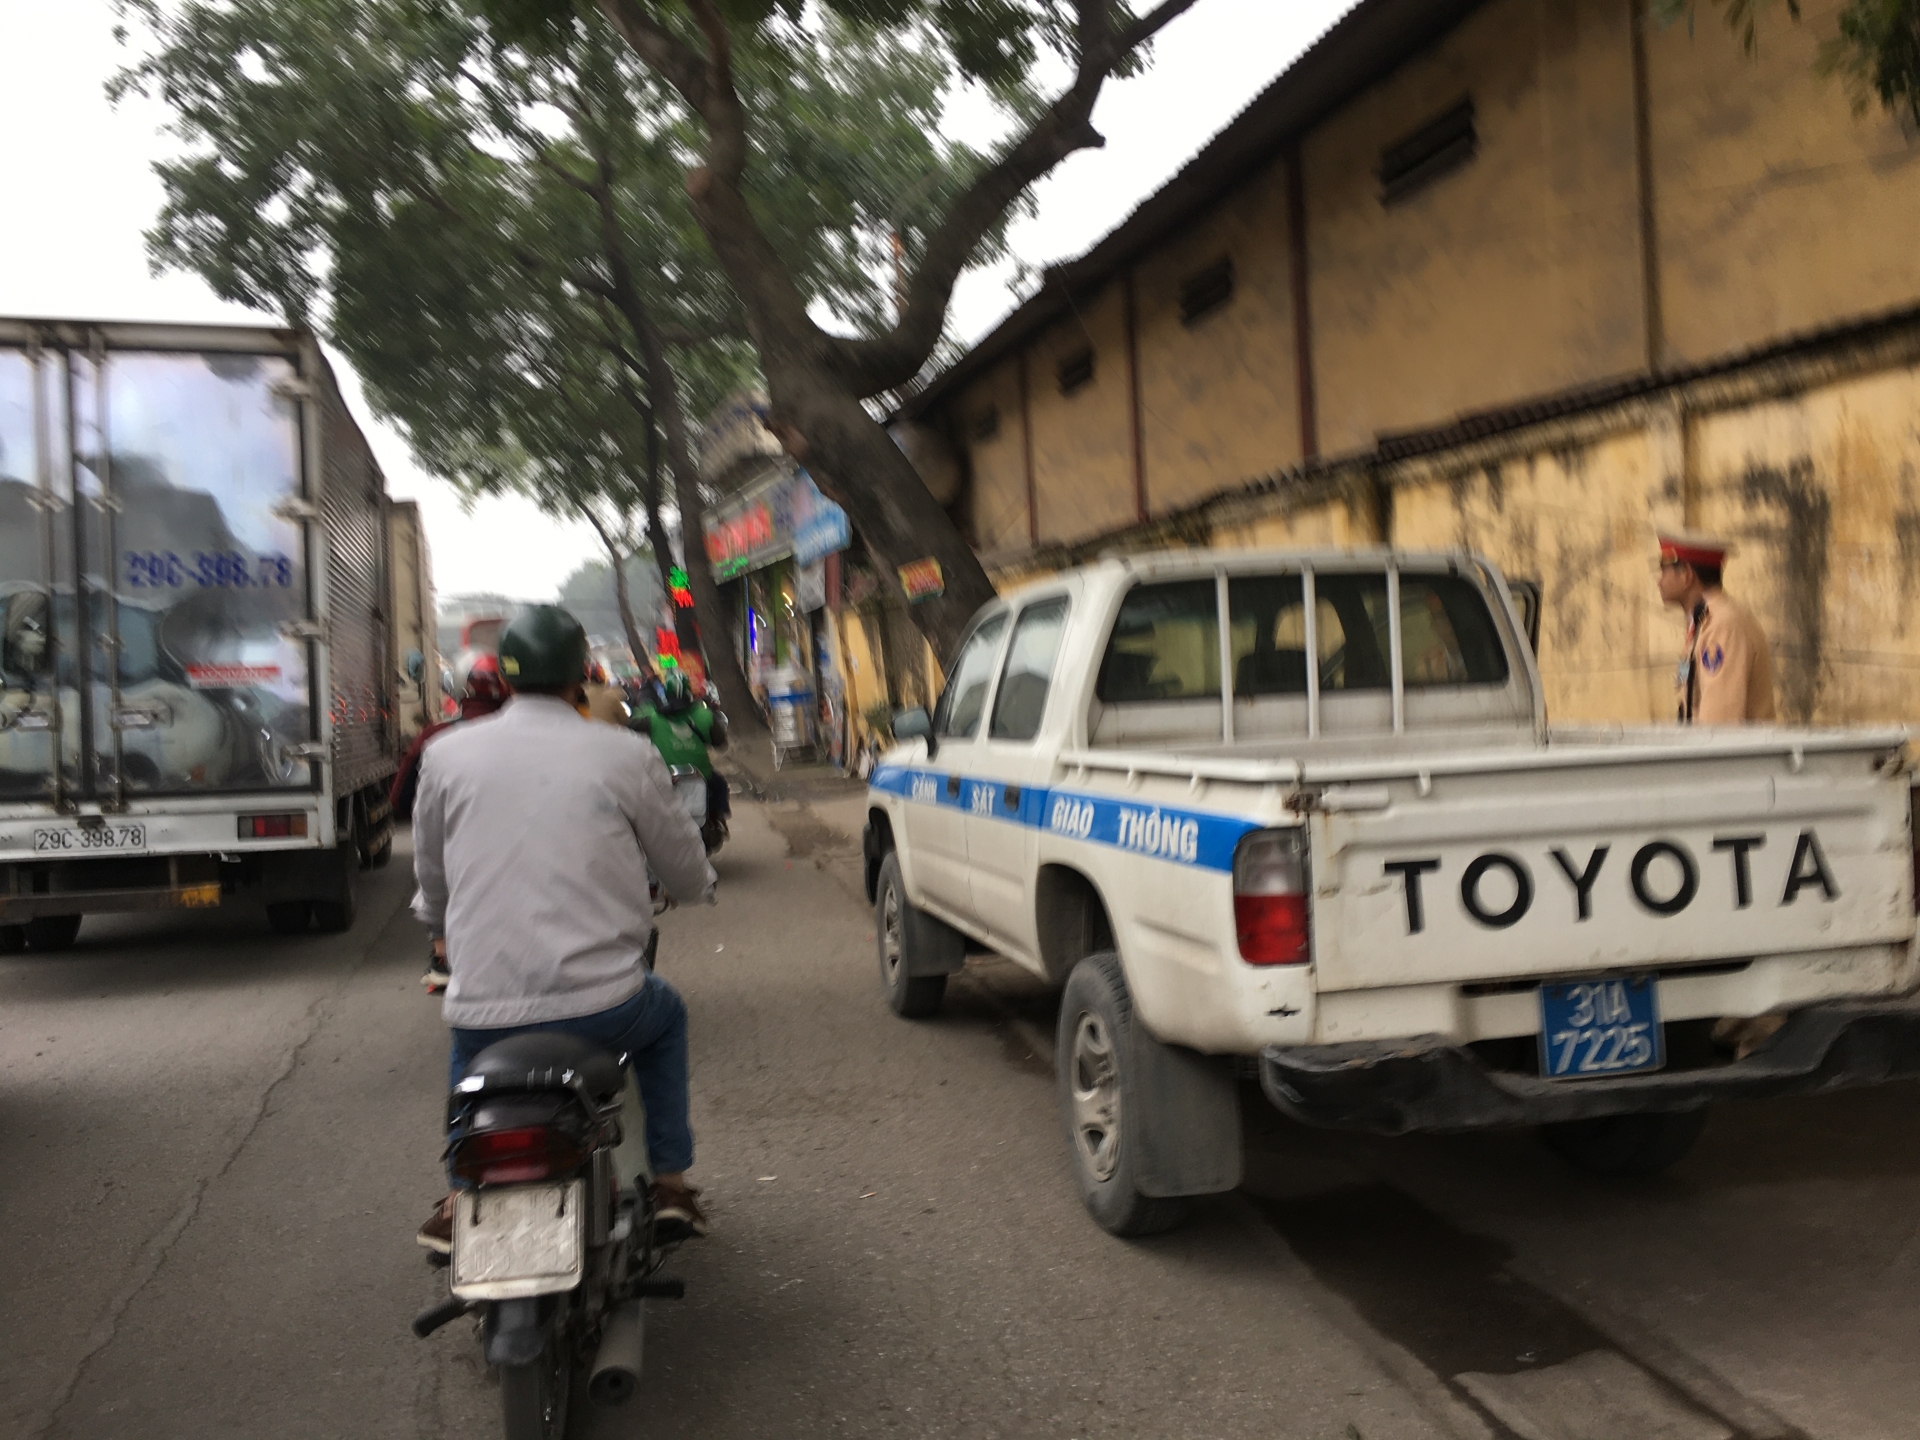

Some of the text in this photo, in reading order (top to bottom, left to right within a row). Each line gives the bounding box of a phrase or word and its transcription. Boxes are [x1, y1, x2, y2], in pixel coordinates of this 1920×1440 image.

[38, 827, 142, 850] 29C-398.78
[971, 783, 995, 815] SÁT
[1052, 799, 1094, 838] GIAO
[1118, 806, 1199, 863] THÔNG
[1382, 828, 1841, 935] TOYOTA
[1566, 982, 1631, 1028] 31A
[1553, 1024, 1652, 1073] 7225
